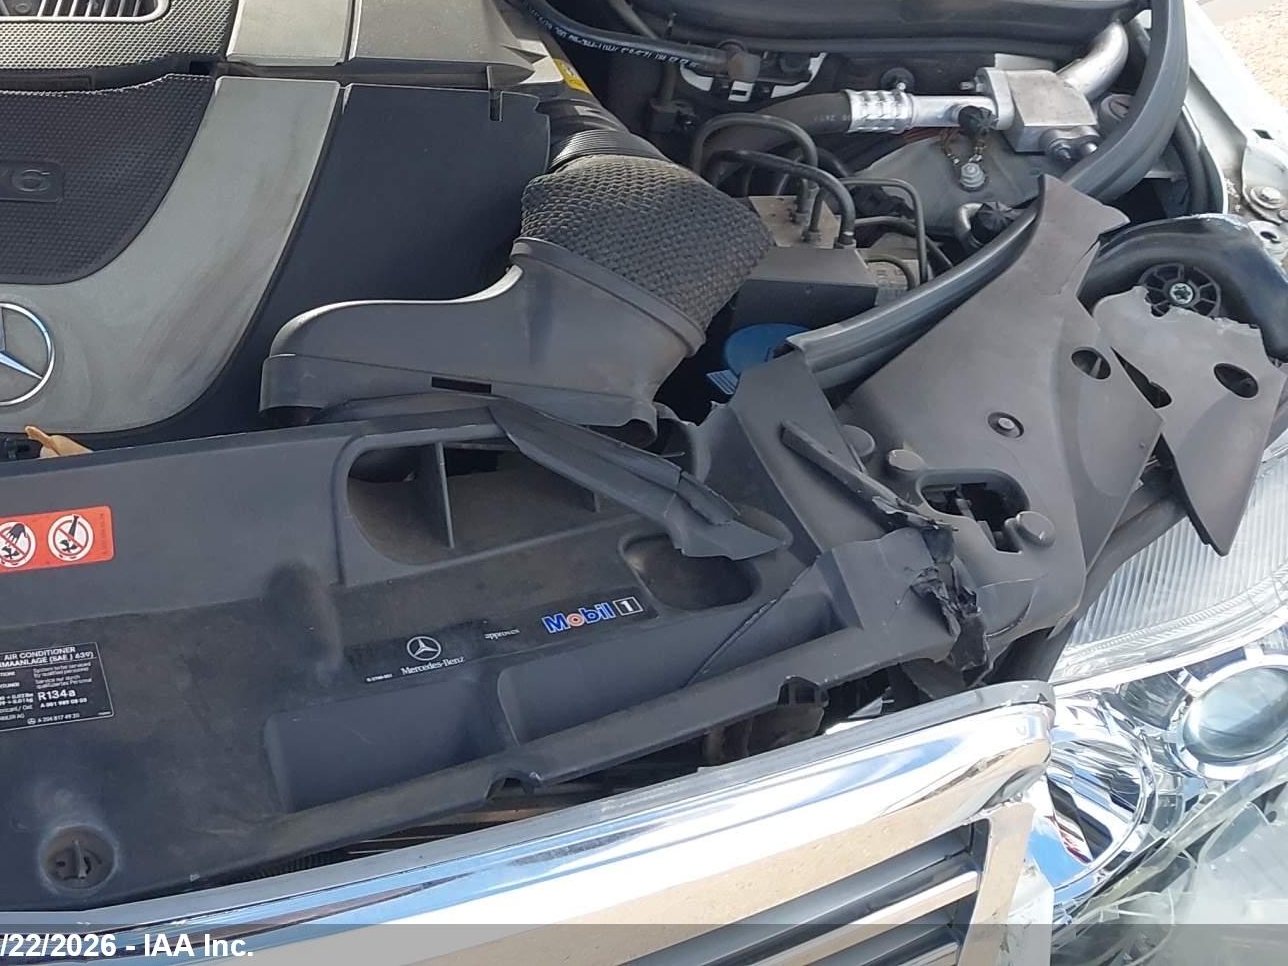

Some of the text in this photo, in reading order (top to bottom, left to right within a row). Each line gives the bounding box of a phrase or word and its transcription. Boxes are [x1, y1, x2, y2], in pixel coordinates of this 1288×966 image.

[541, 602, 616, 634] Mobil
[19, 646, 76, 659] CONDITIONER
[399, 656, 465, 675] Mercedes-Benz
[37, 689, 76, 701] R134a
